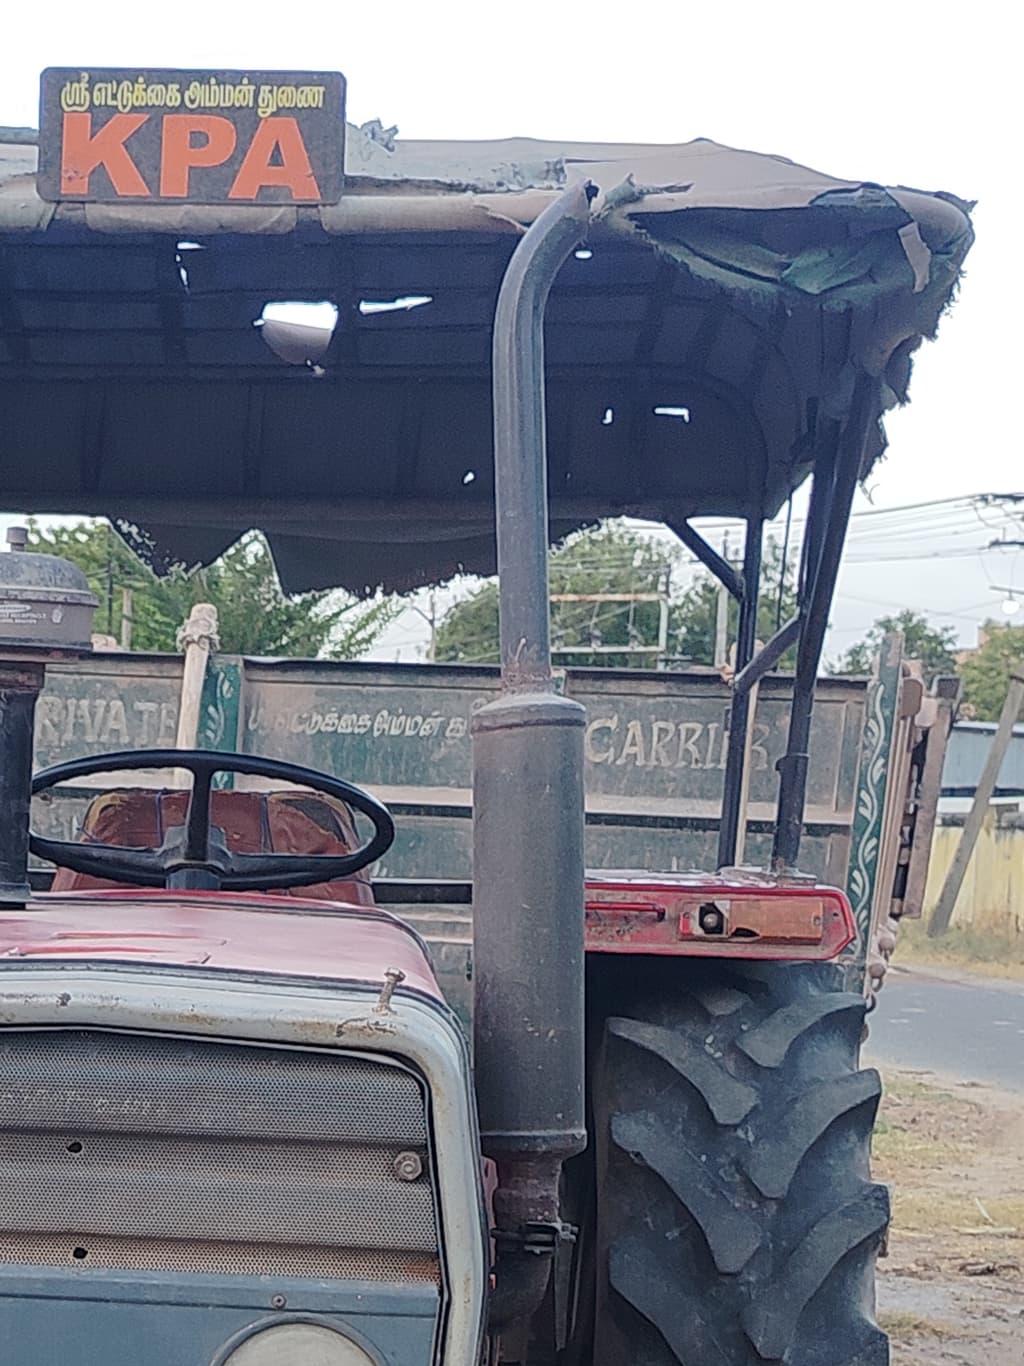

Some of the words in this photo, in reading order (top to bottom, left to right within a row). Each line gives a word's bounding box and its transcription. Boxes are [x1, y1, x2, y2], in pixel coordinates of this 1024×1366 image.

[93, 80, 182, 113] எட்டுக்கை
[184, 77, 255, 109] அம்மன்
[257, 83, 326, 118] துணை
[60, 112, 322, 200] KPA
[35, 696, 177, 744] RIVATE
[584, 712, 769, 770] CARRIR
